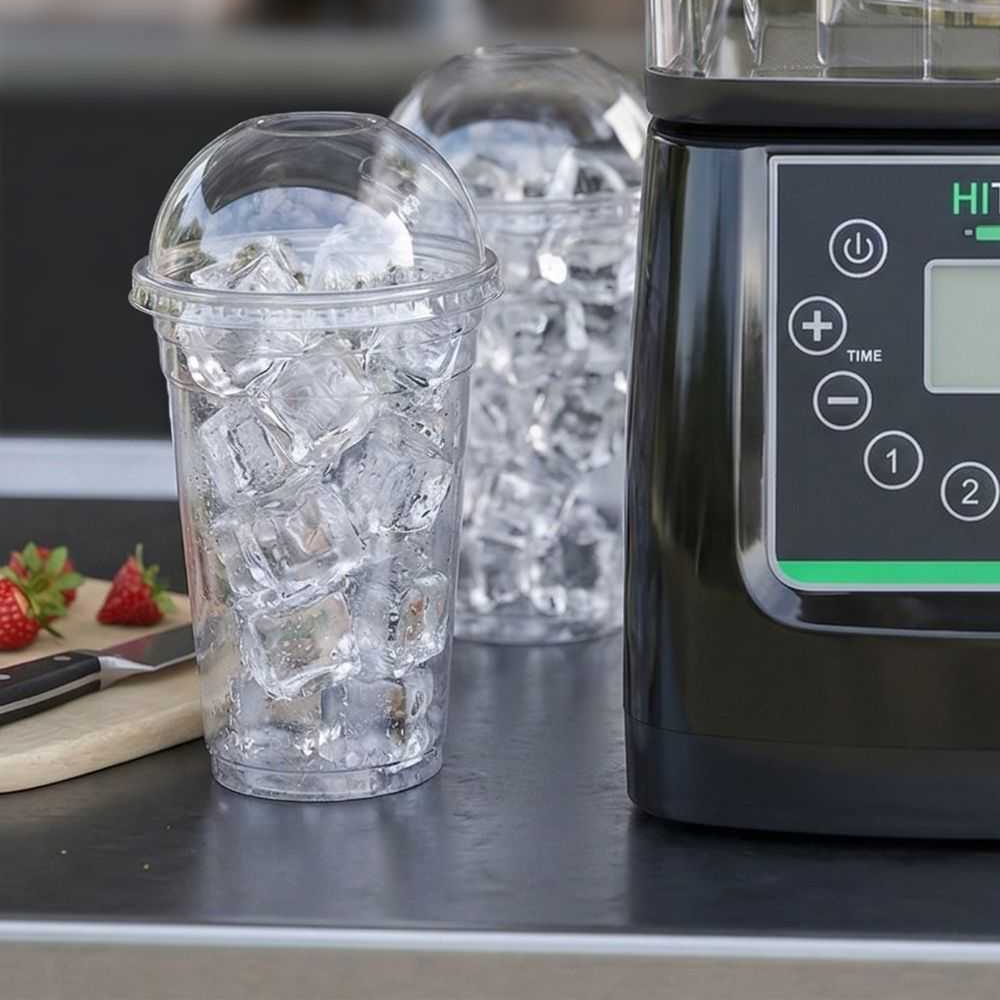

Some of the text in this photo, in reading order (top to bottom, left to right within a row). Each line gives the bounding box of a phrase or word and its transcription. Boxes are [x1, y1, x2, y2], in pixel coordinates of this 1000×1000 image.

[847, 350, 882, 362] TIME
[885, 449, 898, 473] 1
[961, 479, 978, 505] 2
